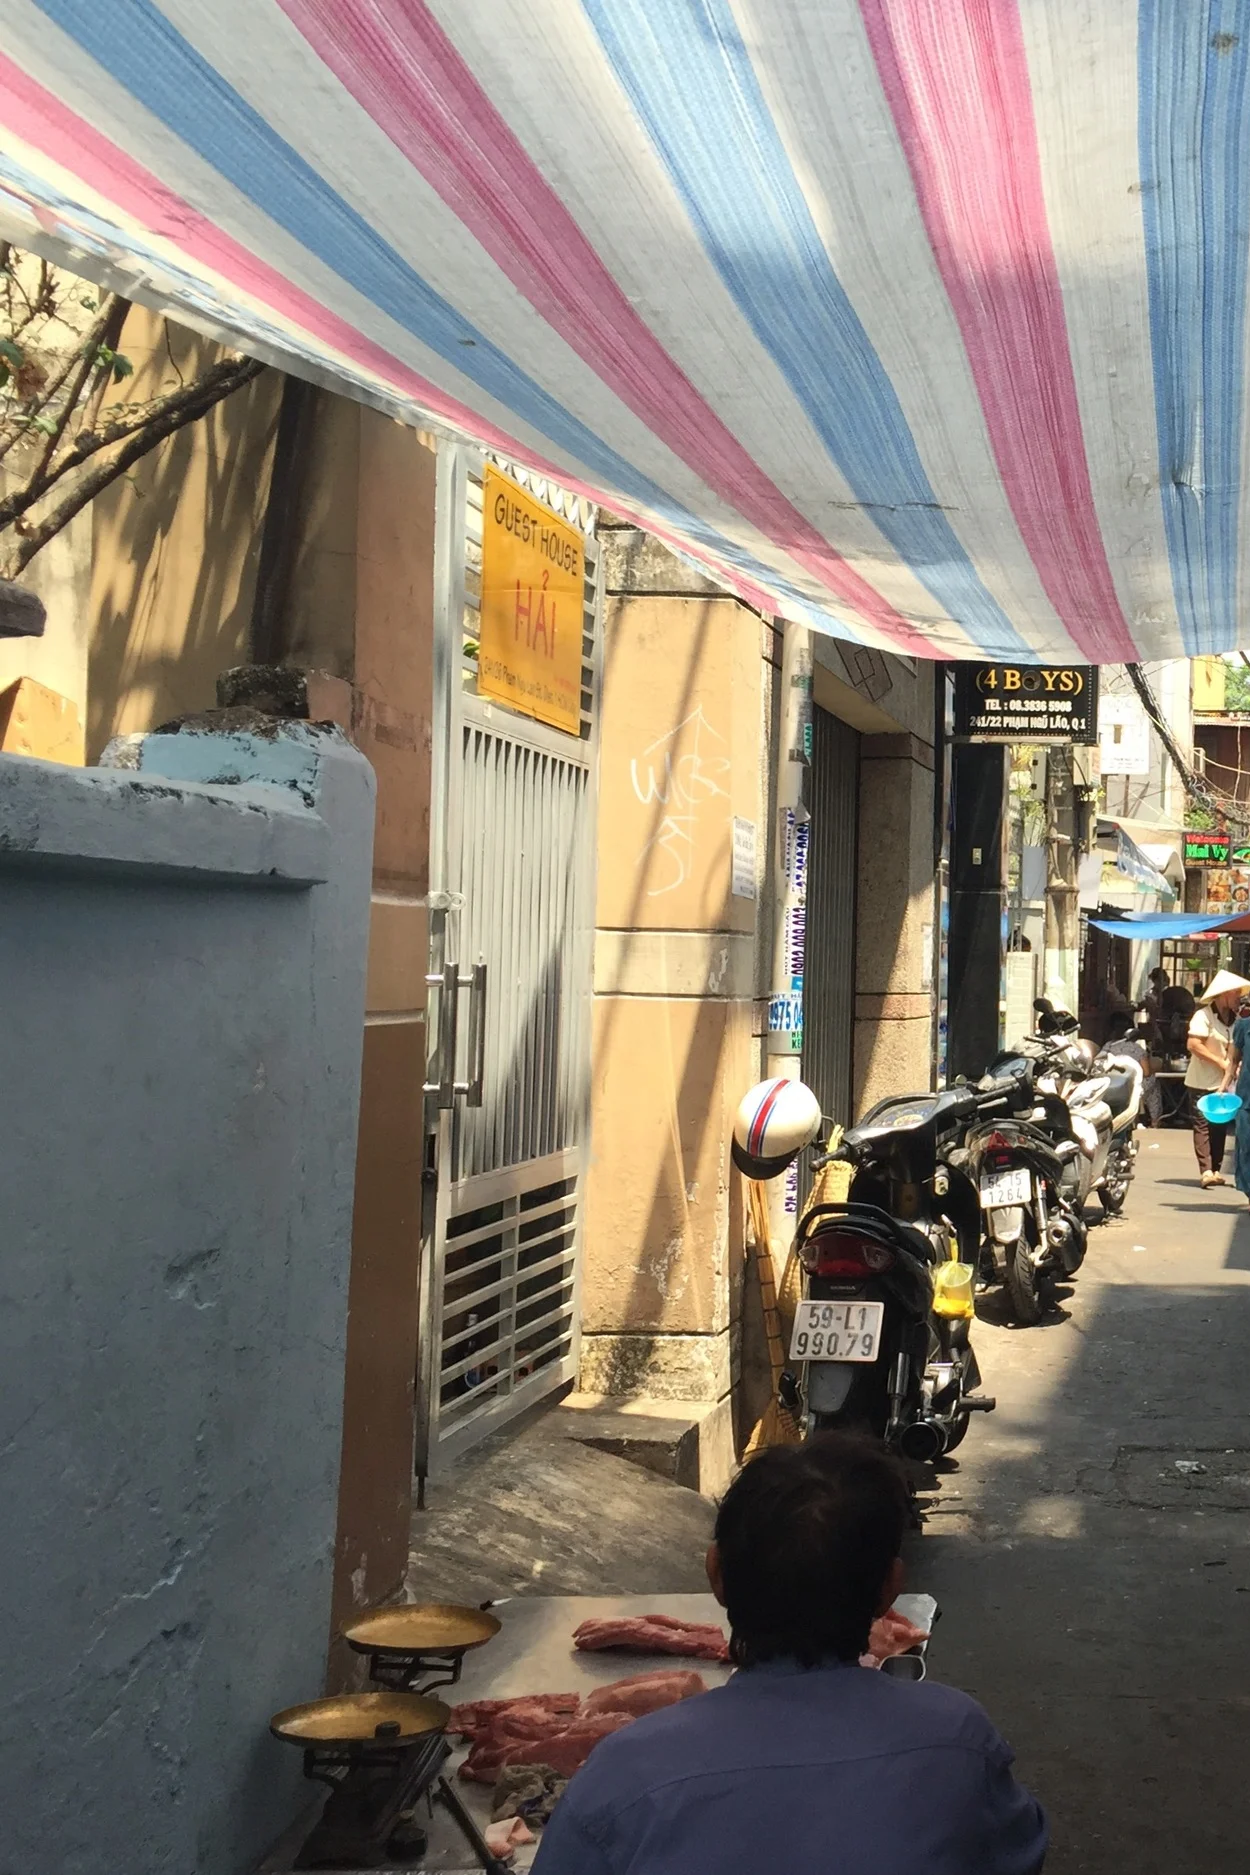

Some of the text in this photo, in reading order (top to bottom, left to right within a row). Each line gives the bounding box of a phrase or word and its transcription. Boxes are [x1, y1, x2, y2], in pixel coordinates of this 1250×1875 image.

[494, 493, 578, 577] GUEST HOUSE
[984, 699, 1002, 711] TEL
[1186, 834, 1230, 844] Welcome
[1211, 844, 1229, 862] Vy
[808, 1306, 867, 1330] 59-L1
[796, 1332, 874, 1356] 990.79
